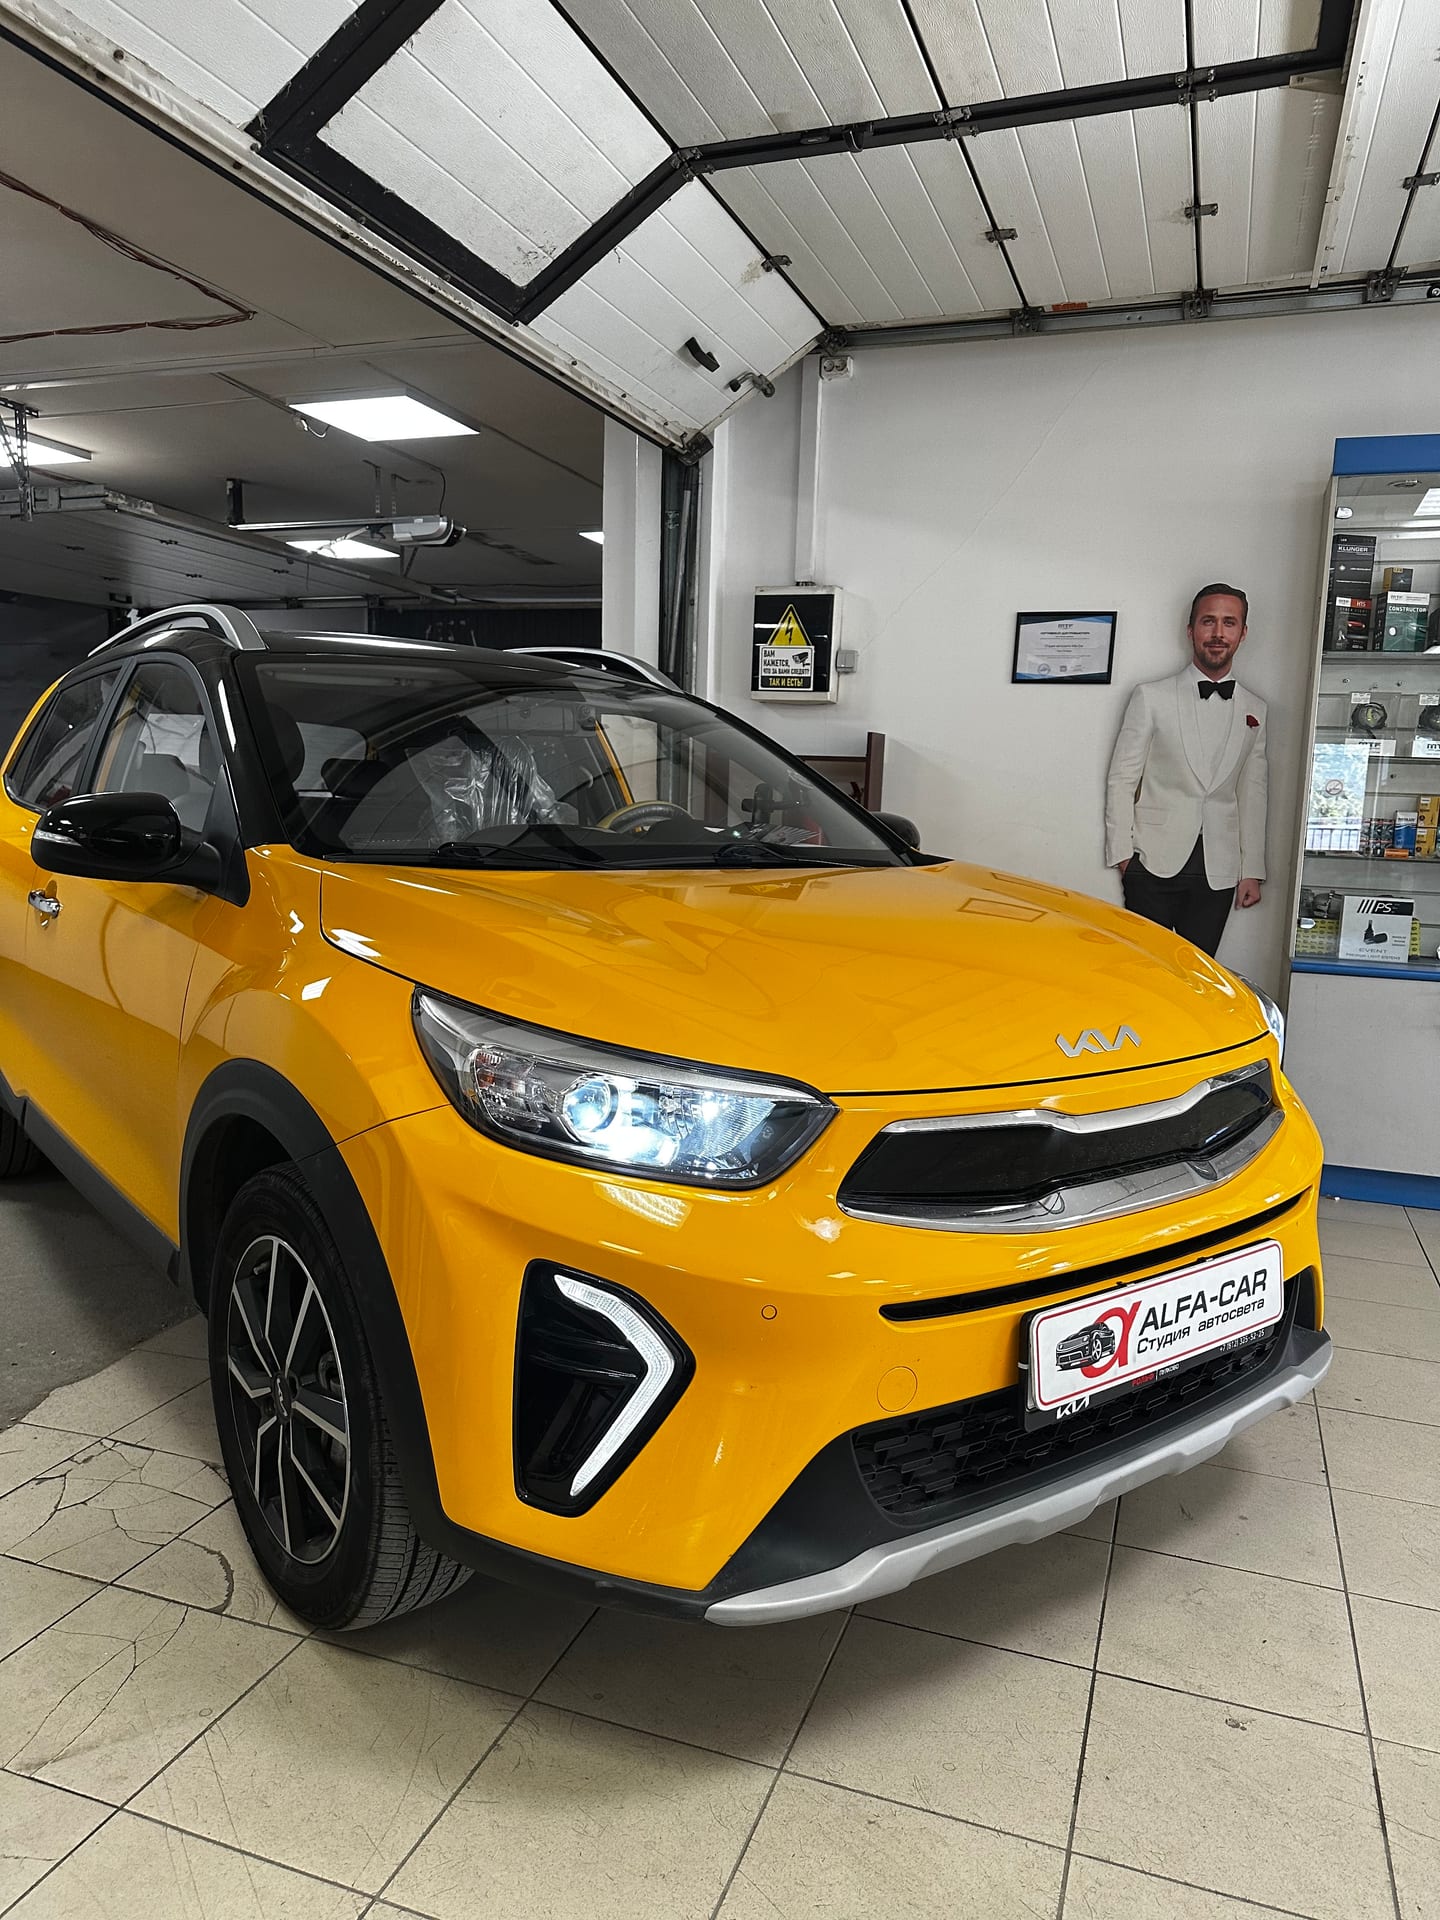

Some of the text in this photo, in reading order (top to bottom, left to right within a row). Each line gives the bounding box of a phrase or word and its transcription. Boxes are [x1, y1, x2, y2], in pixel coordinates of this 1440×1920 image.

[764, 650, 775, 658] ВАМ
[769, 677, 804, 687] ТАК И ЕСТЬ!
[1055, 1024, 1141, 1058] KIA
[1138, 1268, 1267, 1336] ALFA-CAR
[1137, 1298, 1265, 1354] Студия автосвета
[1056, 1395, 1090, 1420] KIA
